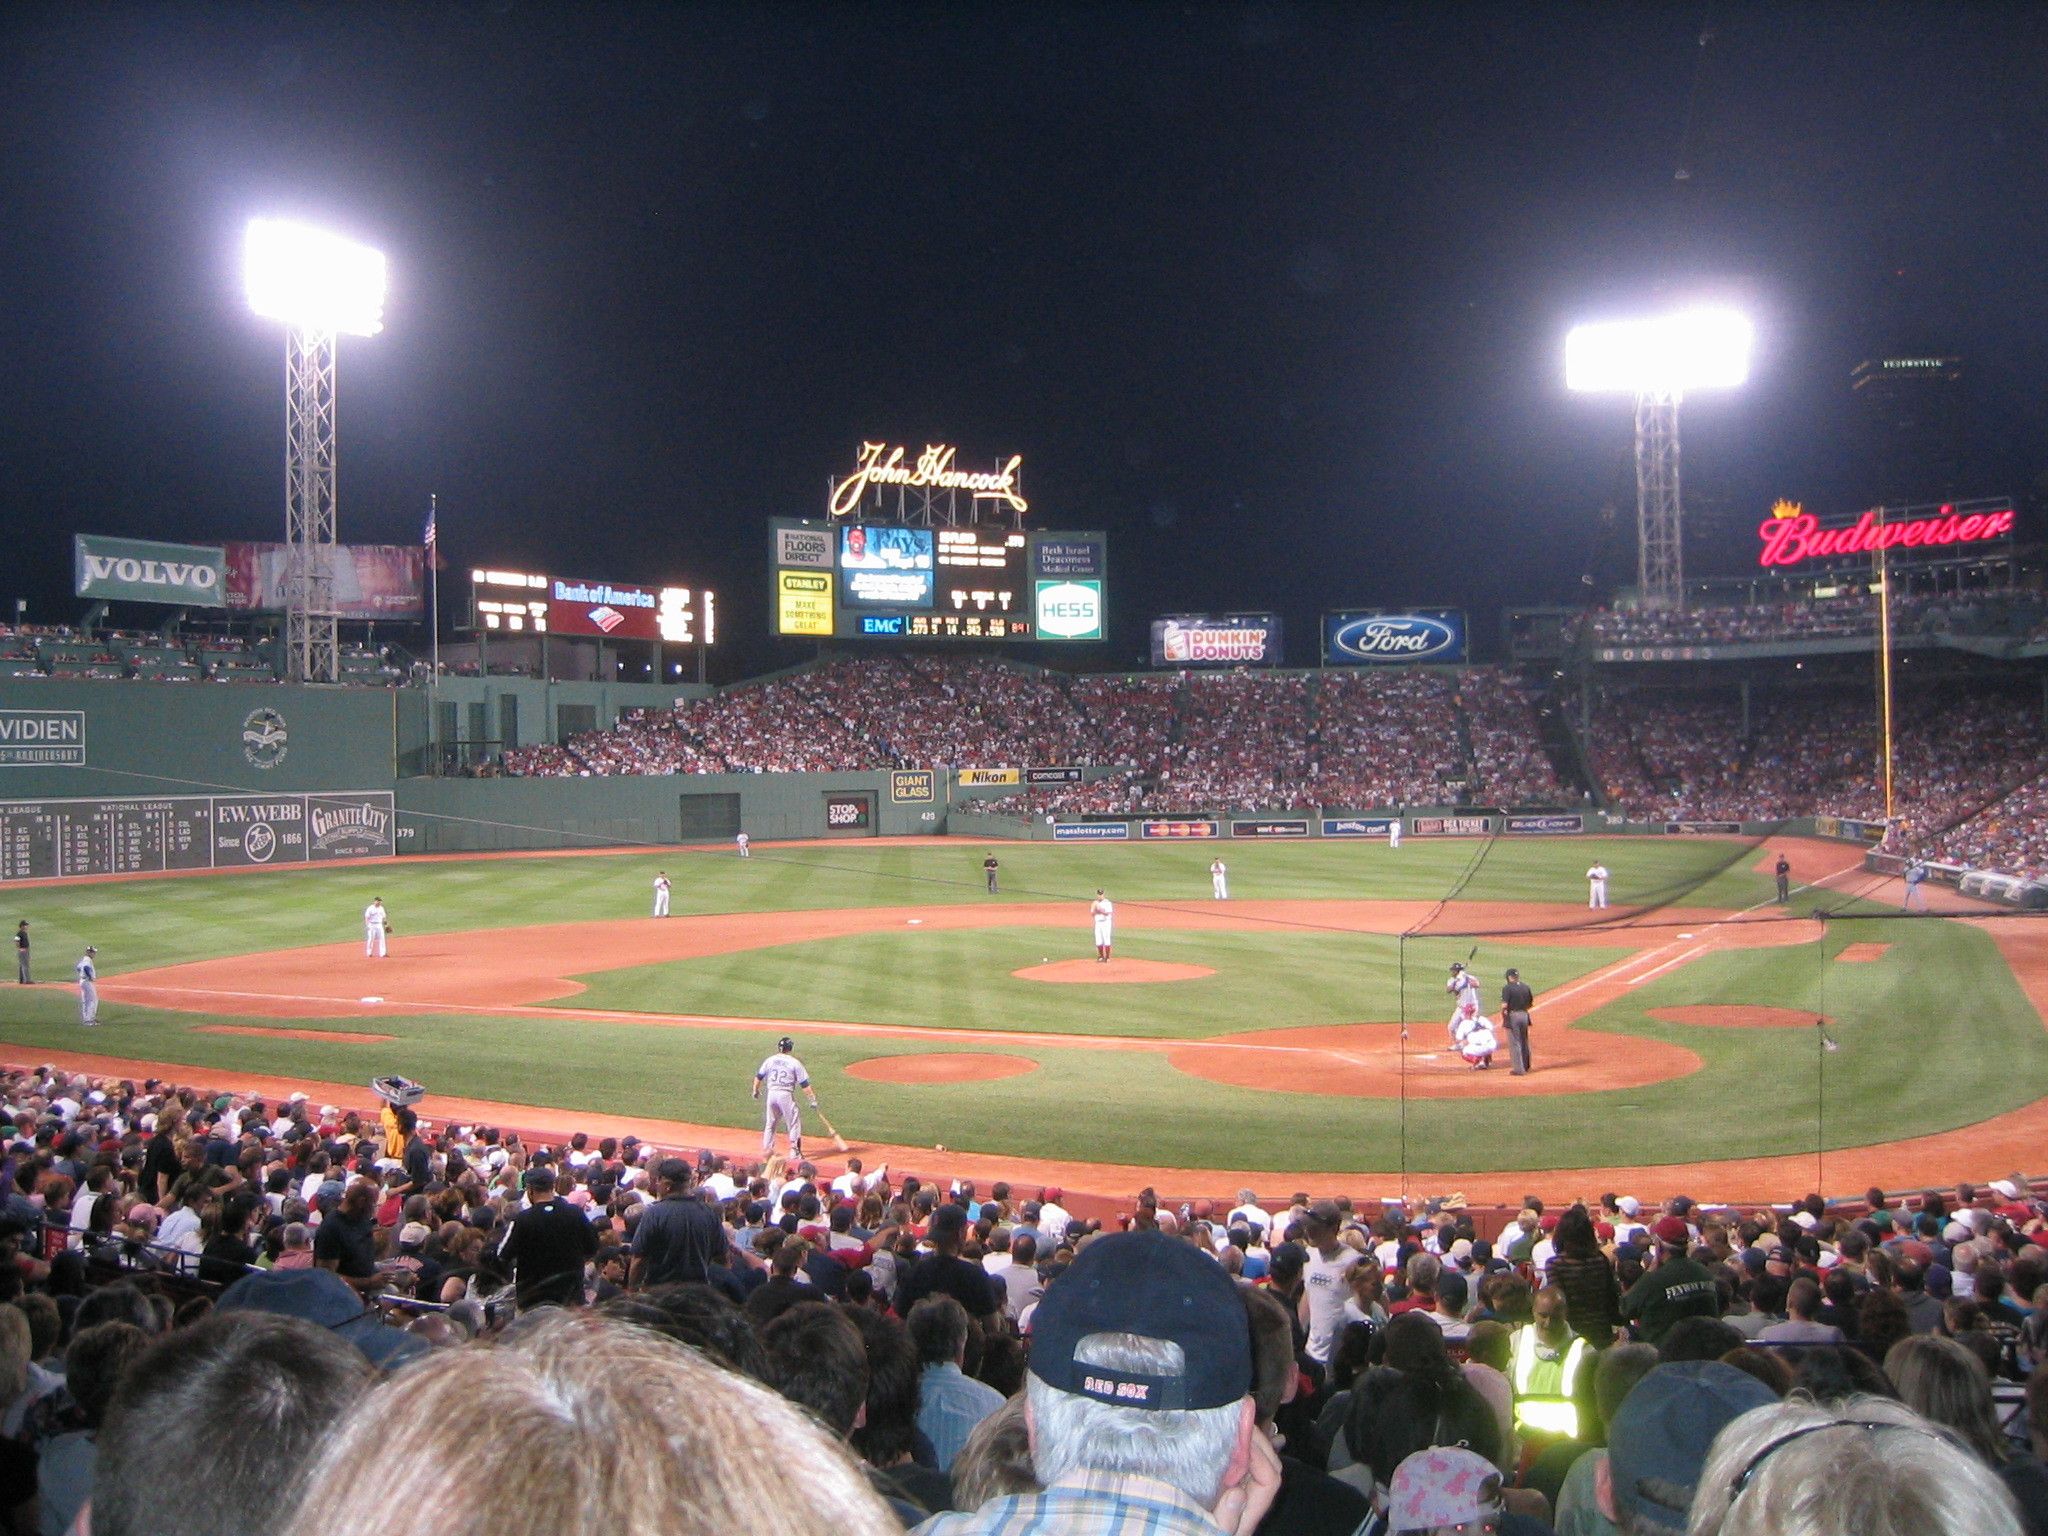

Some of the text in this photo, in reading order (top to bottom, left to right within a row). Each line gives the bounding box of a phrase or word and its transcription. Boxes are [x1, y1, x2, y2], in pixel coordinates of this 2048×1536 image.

[831, 441, 1028, 515] John Hancock
[1759, 504, 2016, 566] Budweiser
[785, 541, 826, 552] FLOORS
[1042, 546, 1090, 555] Beth Israel
[785, 552, 821, 562] DIRECT
[85, 555, 216, 589] VOLVO
[786, 578, 825, 590] STANLEY
[555, 581, 655, 609] Bank of America
[1043, 603, 1094, 617] HESS
[1192, 630, 1266, 646] DUNKIN'
[1359, 622, 1428, 651] Ford
[1191, 646, 1263, 659] DONUTS
[896, 776, 928, 787] GIANT
[972, 771, 1007, 783] Nikon
[895, 787, 929, 797] GLASS
[8, 806, 42, 814] LEAGUE
[218, 804, 302, 823] F.W. WEBB
[830, 804, 855, 815] STOP
[312, 802, 388, 837] GRANITE CITY
[397, 828, 415, 838] 379
[219, 836, 240, 848] Since
[282, 834, 302, 845] 1866
[1084, 1376, 1149, 1400] RED SOX
